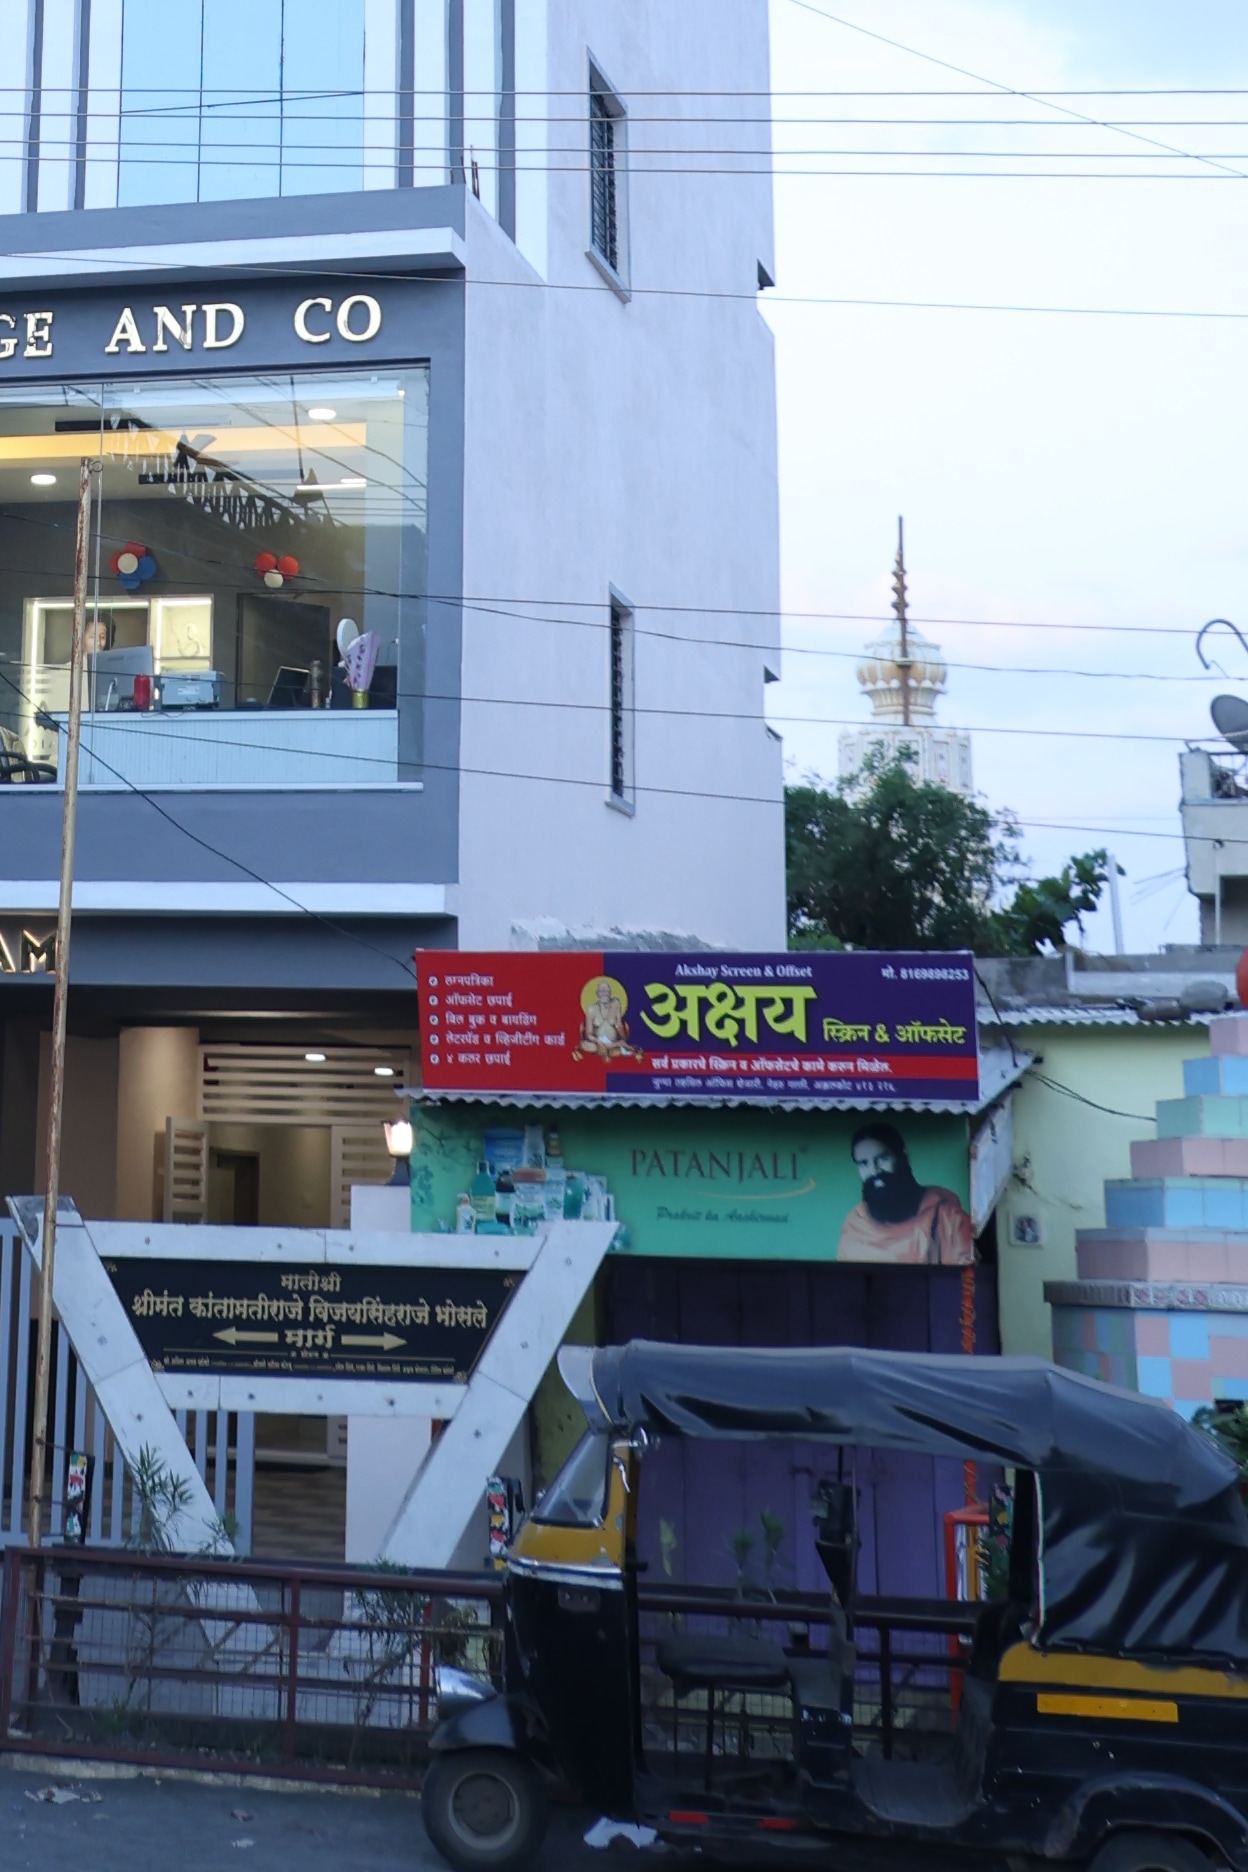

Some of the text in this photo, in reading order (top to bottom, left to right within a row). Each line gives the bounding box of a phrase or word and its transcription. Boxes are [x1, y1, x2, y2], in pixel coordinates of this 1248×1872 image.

[106, 302, 244, 352] AND
[293, 293, 382, 344] CO
[674, 963, 813, 980] Akshay Screen & Offset
[640, 981, 817, 1048] अक्षय
[874, 1022, 890, 1043] &
[894, 1017, 967, 1045] ऑफसेट
[631, 1148, 799, 1183] PATANJALI
[132, 1288, 184, 1318] श्रीमंत
[309, 1294, 430, 1327] विजयसिंहराजे
[436, 1298, 488, 1329] भोसले
[285, 1324, 336, 1349] मार्ग
